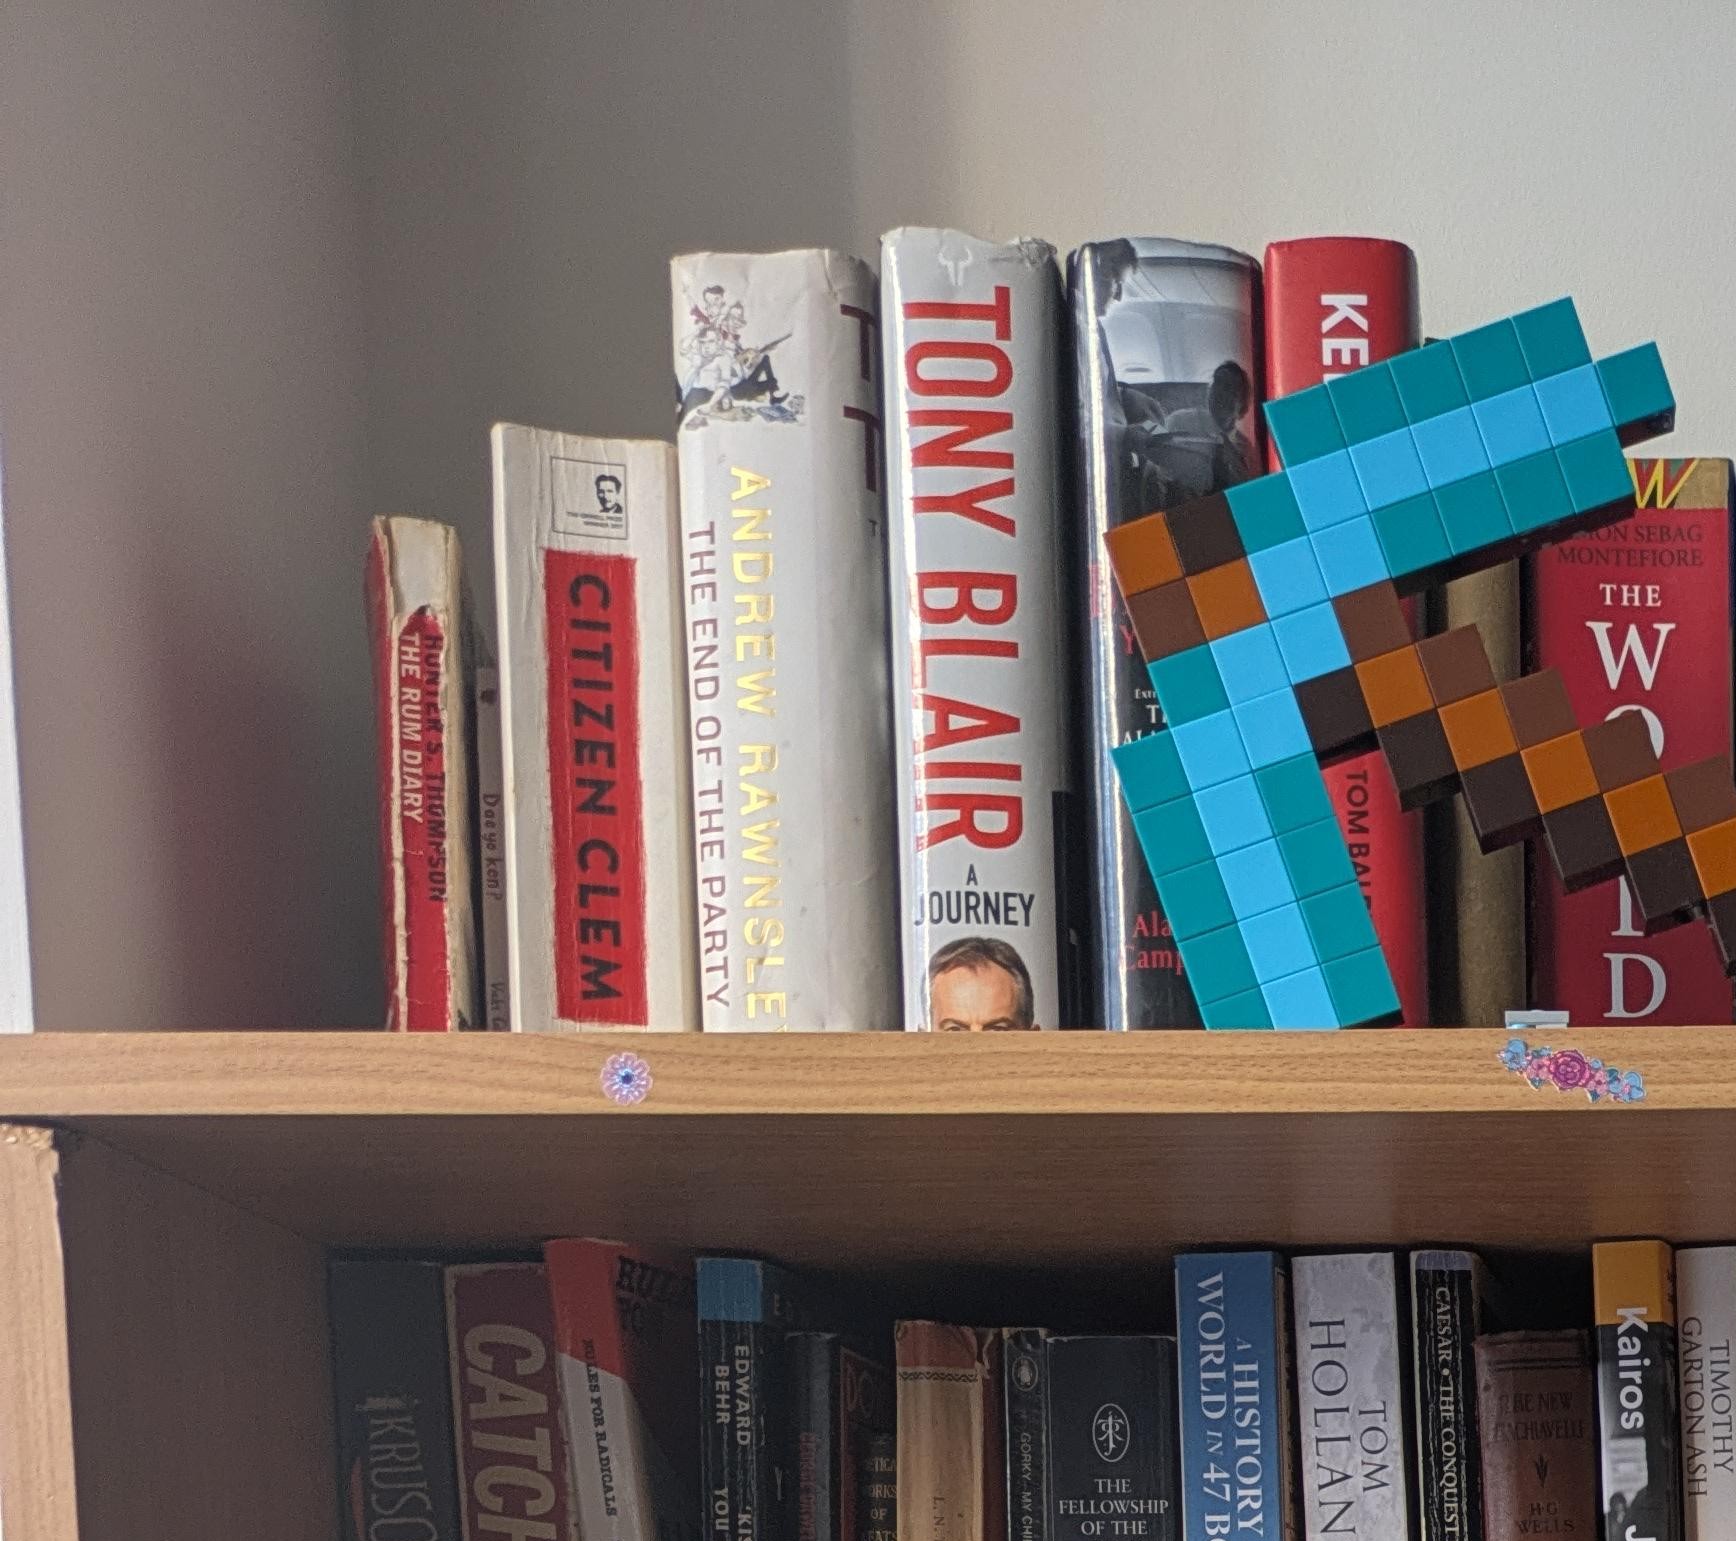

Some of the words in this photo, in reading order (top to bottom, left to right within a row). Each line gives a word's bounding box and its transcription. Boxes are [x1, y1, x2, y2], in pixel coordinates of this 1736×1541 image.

[901, 285, 1016, 537] TONY
[400, 633, 420, 679] THE
[401, 686, 421, 741] RUM
[567, 573, 617, 812] CITIZEN
[913, 572, 1023, 851] BLAIR
[401, 746, 422, 823] DIARY
[966, 865, 977, 885] A
[576, 831, 622, 1002] CLEM
[913, 892, 1034, 927] JOURNEY
[1196, 1272, 1226, 1430] WORLD
[1237, 1337, 1250, 1351] A
[1614, 1306, 1650, 1430] Kairos
[1206, 1431, 1223, 1455] IN
[1231, 1361, 1264, 1536] HISTORY
[1358, 1401, 1390, 1493] TOM
[1058, 1499, 1169, 1515] FELLOWSHIP
[1094, 1479, 1132, 1493] THE
[1201, 1463, 1233, 1507] 47
[1081, 1521, 1103, 1535] OF
[1111, 1521, 1148, 1536] THE
